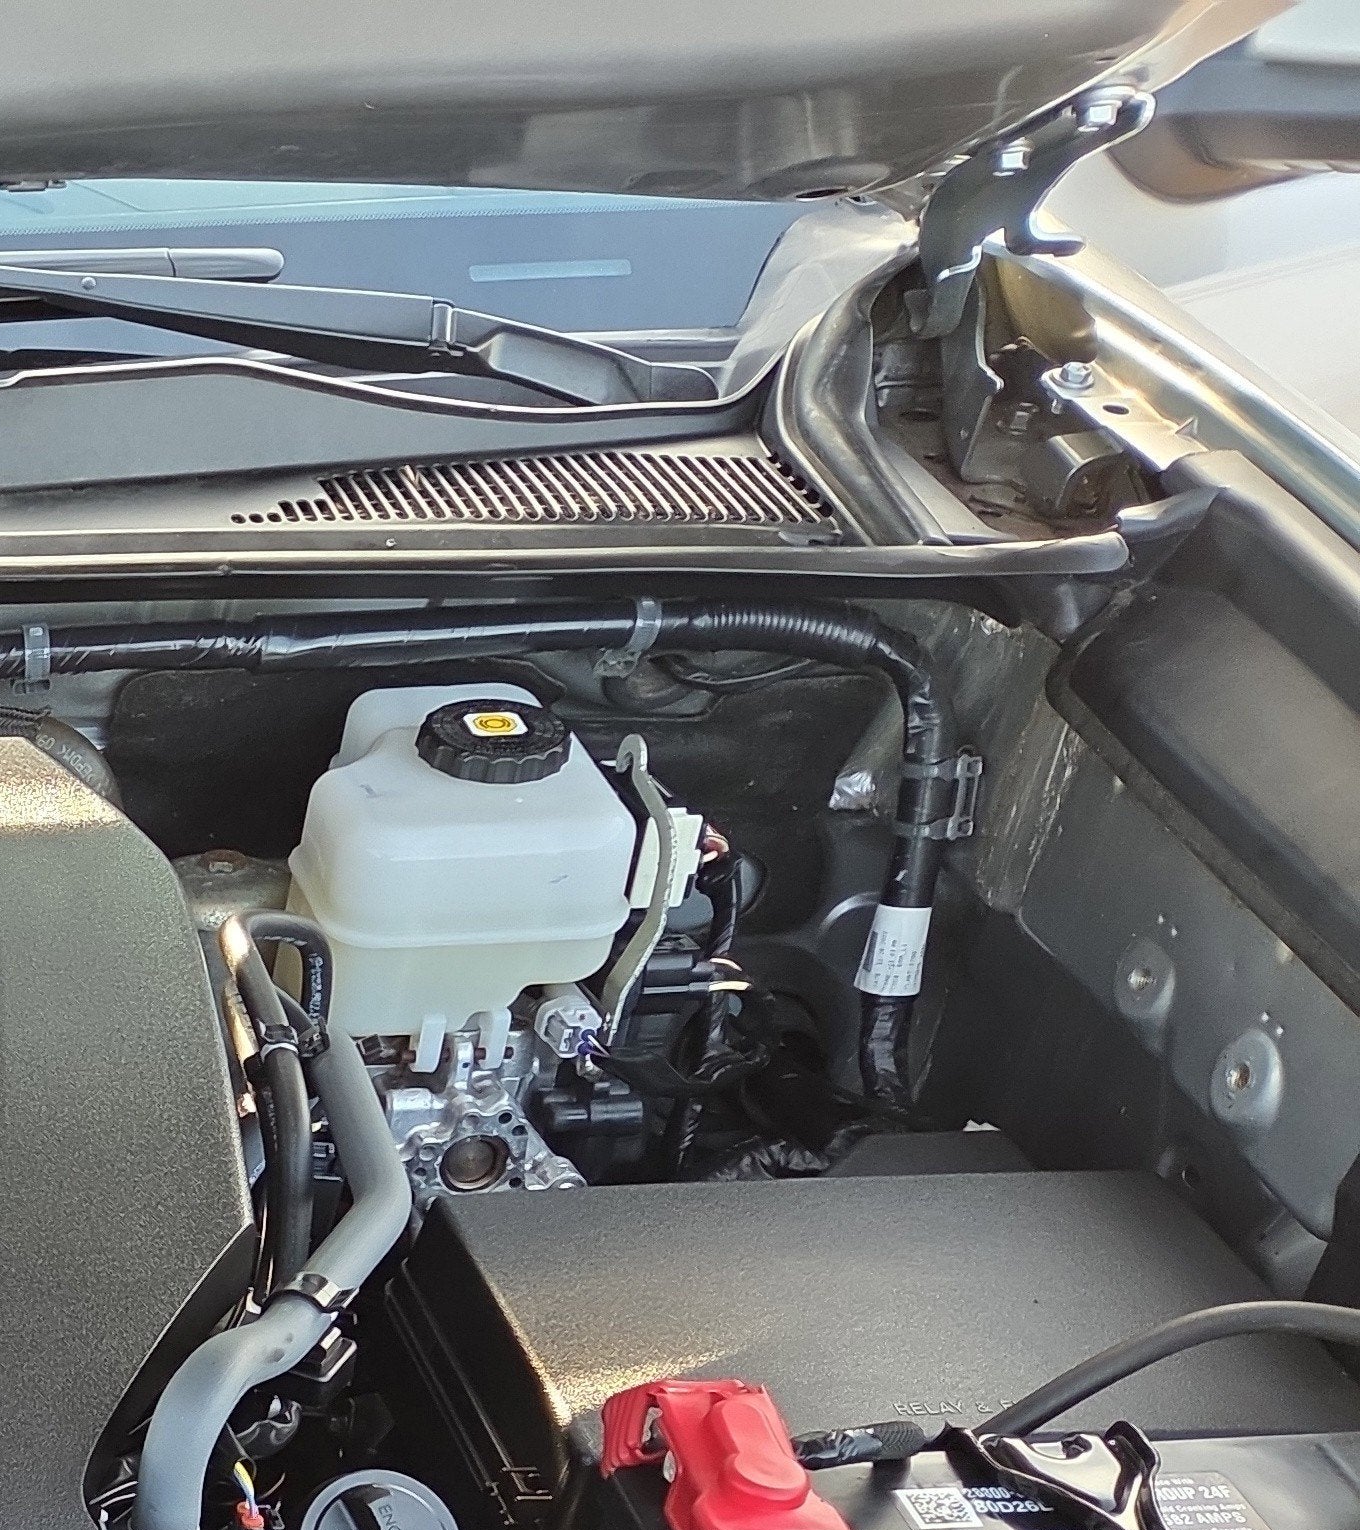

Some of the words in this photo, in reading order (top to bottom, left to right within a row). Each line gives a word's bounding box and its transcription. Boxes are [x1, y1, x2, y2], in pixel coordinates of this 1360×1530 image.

[893, 1400, 964, 1417] RELAY
[976, 1401, 994, 1414] &
[1198, 1485, 1231, 1500] 24F
[972, 1499, 1055, 1515] 80D26L
[1195, 1511, 1247, 1525] AMPS
